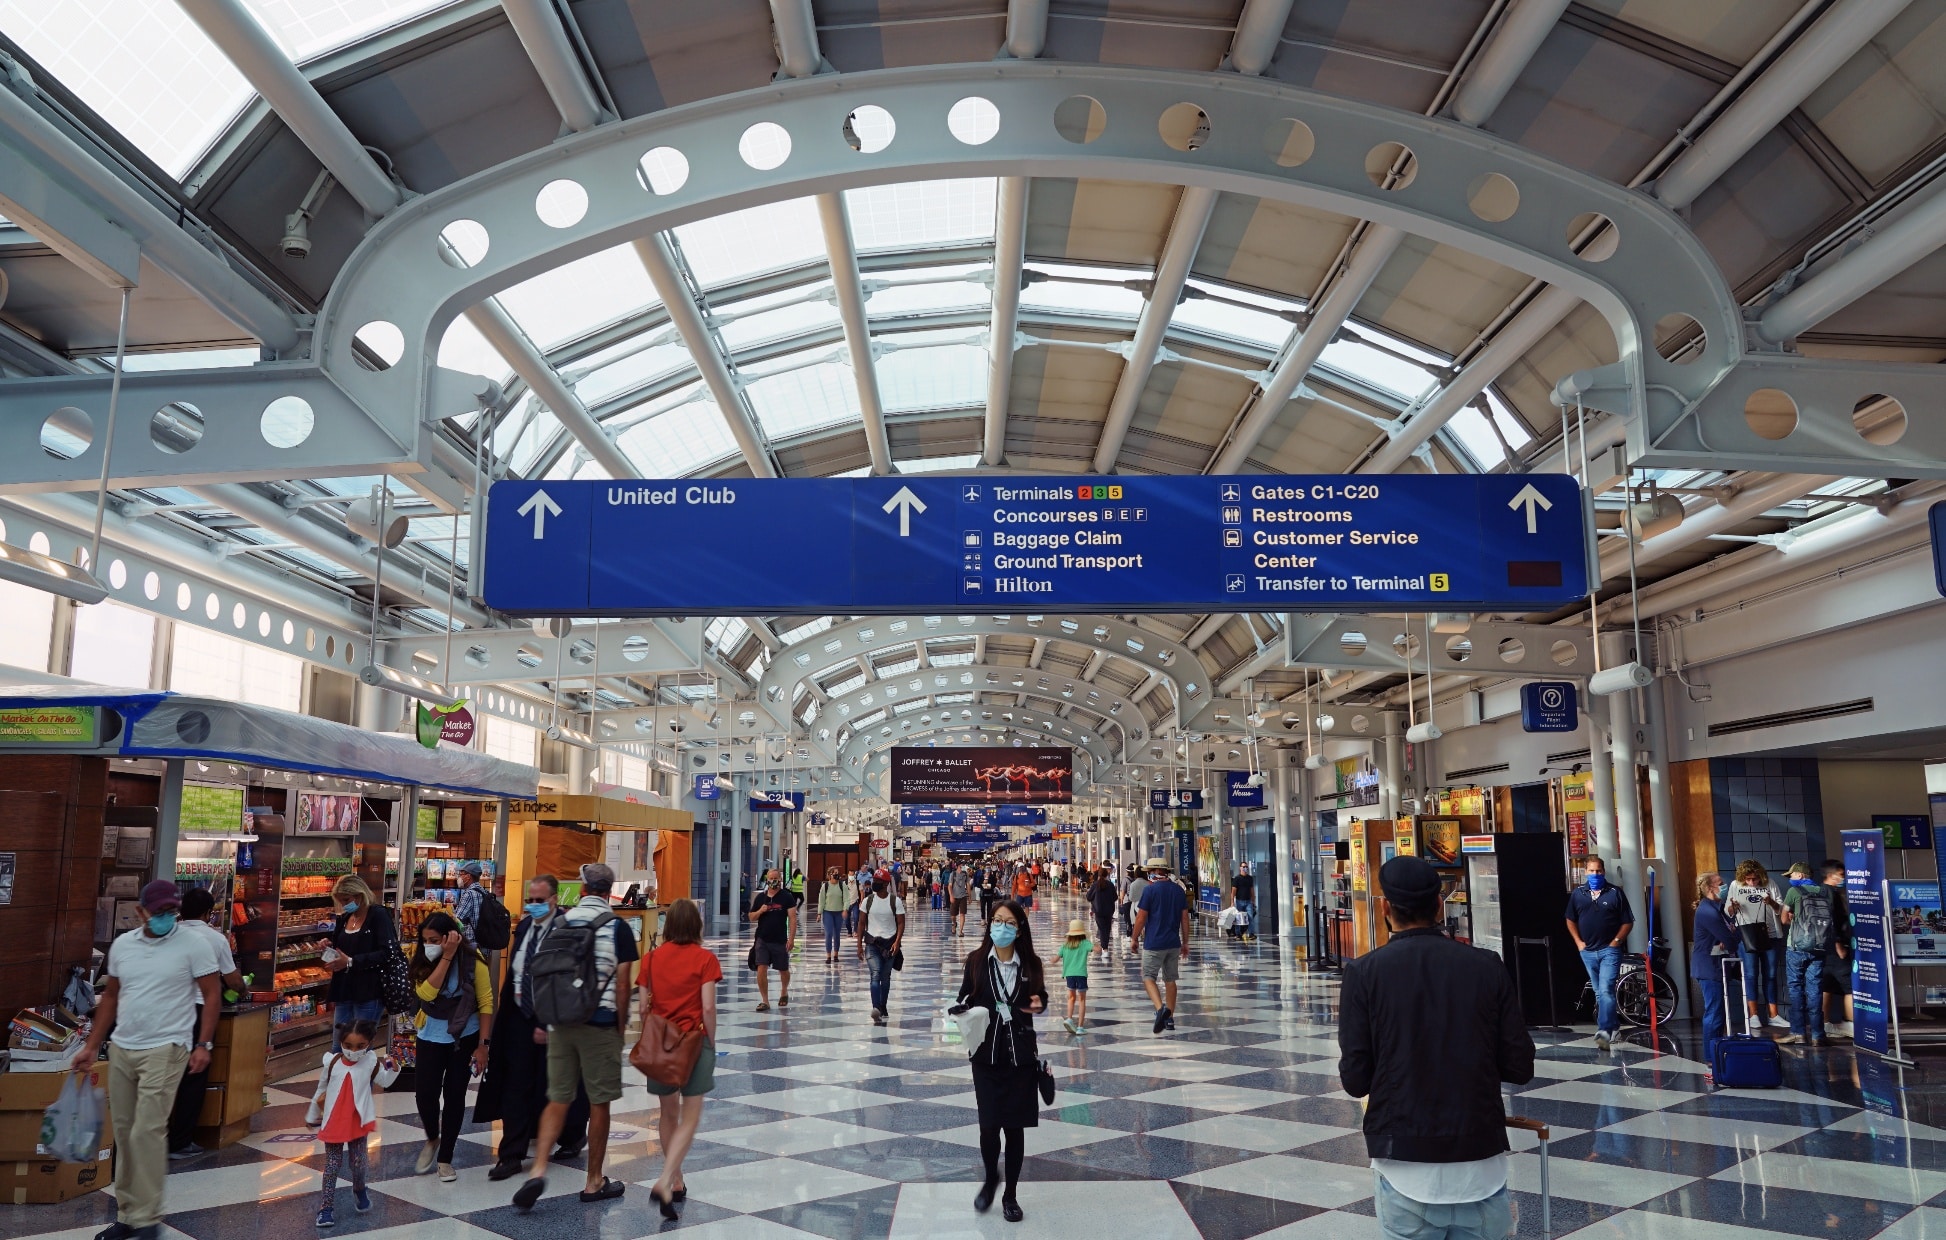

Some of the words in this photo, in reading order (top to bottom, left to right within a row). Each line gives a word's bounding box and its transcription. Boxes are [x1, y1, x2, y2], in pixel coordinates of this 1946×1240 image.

[607, 487, 677, 506] United
[685, 486, 736, 505] Club
[993, 486, 1074, 501] Terminals
[1252, 485, 1306, 500] Gates
[1311, 484, 1379, 500] C1-C20
[993, 508, 1098, 524] Concourses
[1104, 509, 1113, 520] B
[1120, 509, 1129, 520] E
[1136, 509, 1144, 520] F
[1252, 508, 1353, 523] Restrooms
[993, 531, 1070, 550] Baggage
[1074, 530, 1122, 546] Claim
[1253, 530, 1344, 546] Customer
[1349, 530, 1419, 545] Service
[994, 554, 1058, 570] Ground
[1059, 553, 1143, 572] Transport
[1254, 553, 1318, 569] Center
[994, 576, 1054, 593] Hilton
[1255, 576, 1326, 591] Transfer
[1329, 576, 1348, 591] to
[1351, 575, 1425, 590] Terminal
[1, 714, 34, 723] Market
[37, 714, 49, 723] On
[49, 714, 65, 723] The
[65, 714, 77, 723] Go
[444, 720, 472, 730] Market
[441, 731, 454, 739] The
[901, 758, 934, 766] JOFFREY
[1231, 789, 1253, 797] News
[523, 801, 557, 813] horse
[1884, 824, 1894, 838] 2
[1909, 825, 1919, 838] 1
[185, 863, 233, 875] BEVERAGES
[283, 861, 323, 872] SANDWICHES
[329, 861, 350, 872] SALADS
[1897, 887, 1917, 900] 2X
